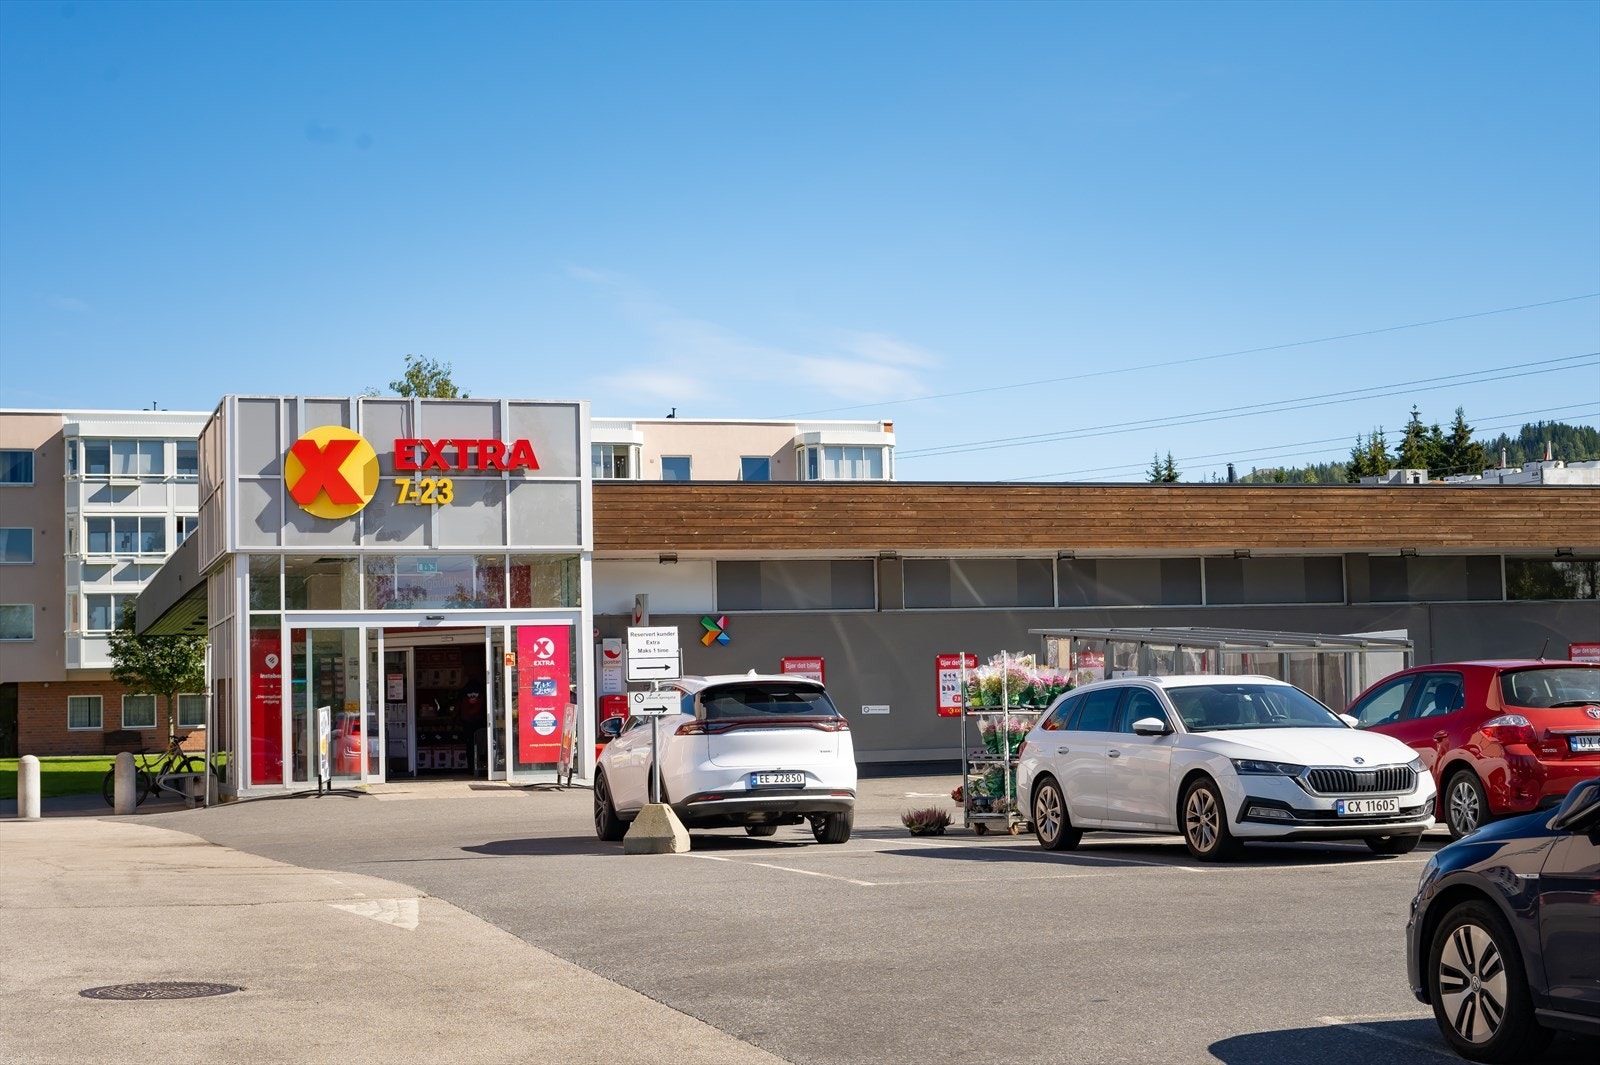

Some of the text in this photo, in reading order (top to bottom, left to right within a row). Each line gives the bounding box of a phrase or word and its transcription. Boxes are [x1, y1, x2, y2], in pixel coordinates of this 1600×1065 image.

[394, 438, 540, 470] EXTRA
[395, 478, 454, 504] 7-23
[1579, 737, 1594, 748] UX
[760, 774, 802, 783] EE 22850
[1347, 800, 1395, 812] CX 11605
